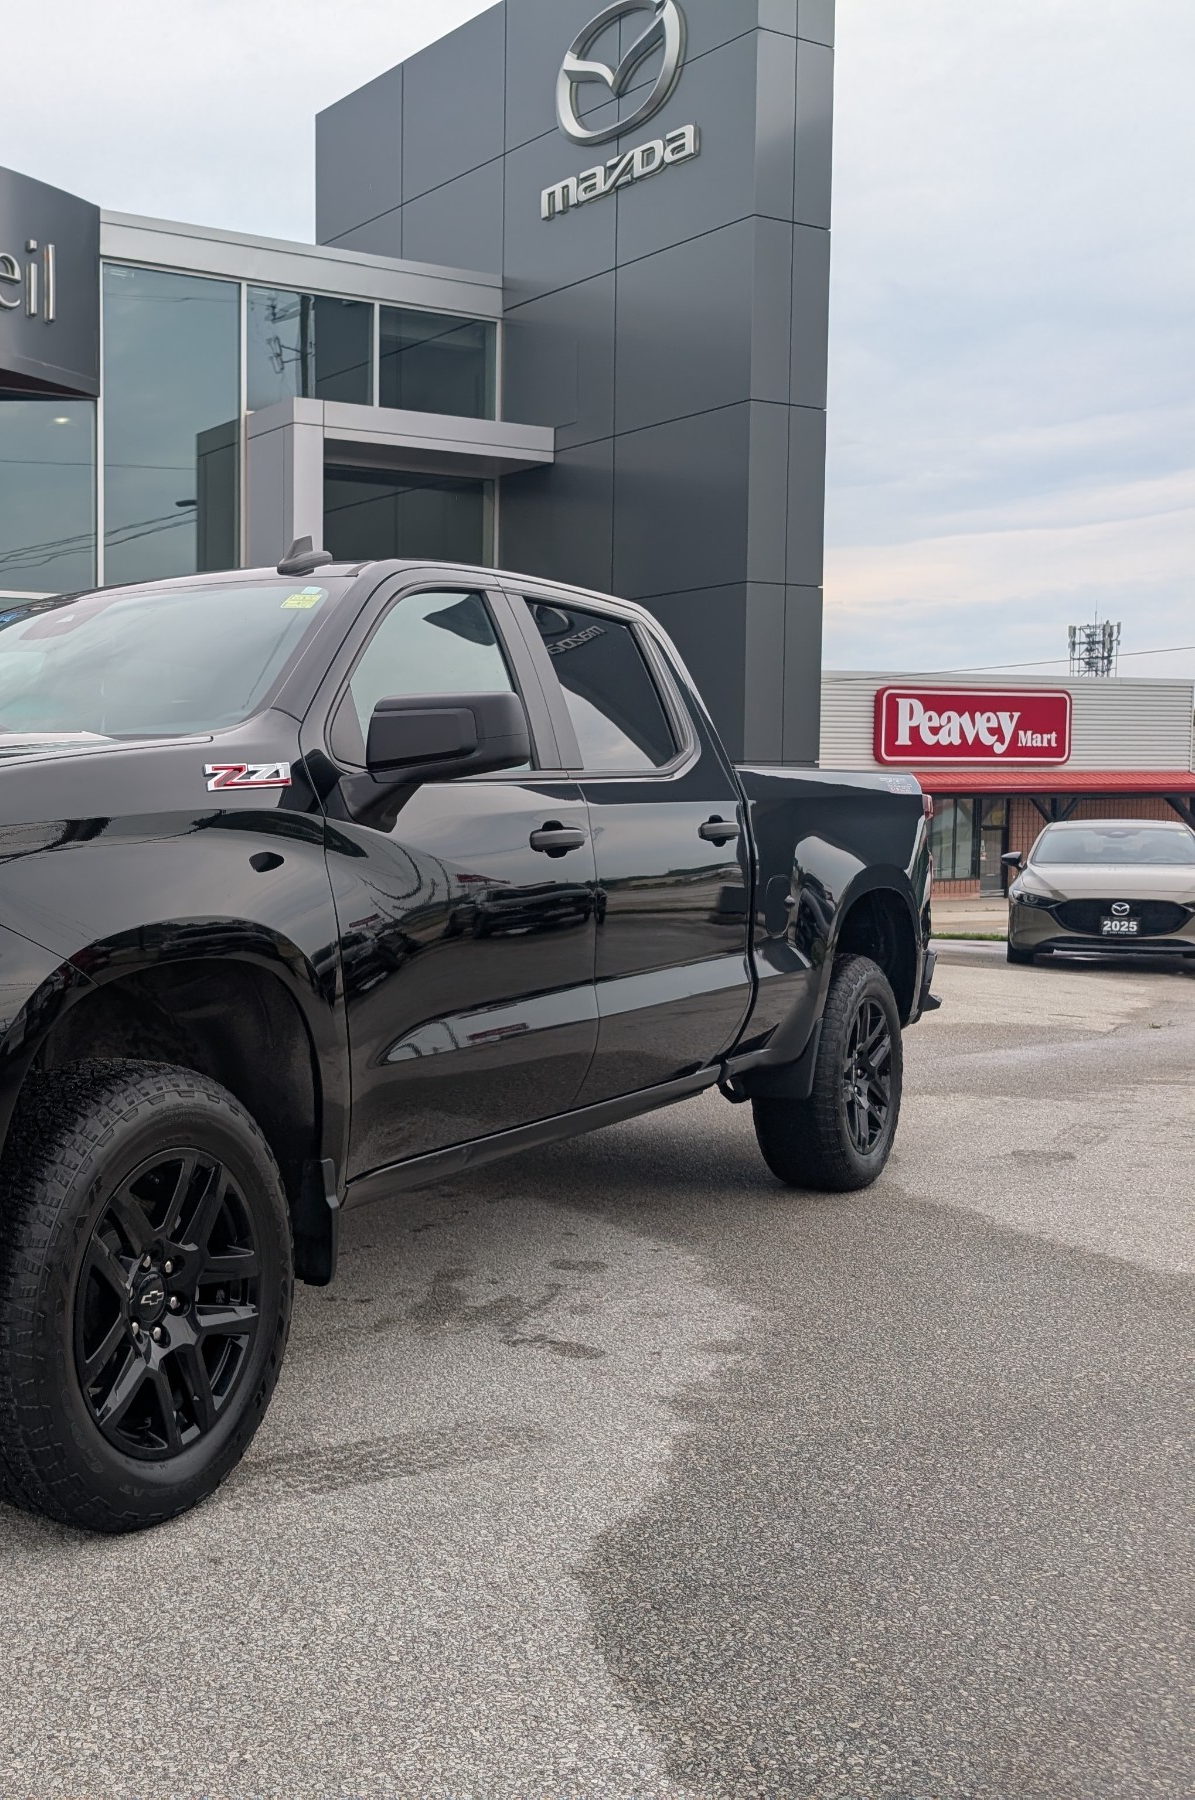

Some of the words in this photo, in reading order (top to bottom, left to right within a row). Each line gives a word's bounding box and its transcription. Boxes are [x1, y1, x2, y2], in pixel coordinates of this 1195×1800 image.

[540, 123, 700, 221] mazda
[895, 698, 1021, 754] Peavey
[1017, 730, 1057, 747] Mart
[204, 762, 292, 791] Z71
[1103, 920, 1138, 931] 2025
